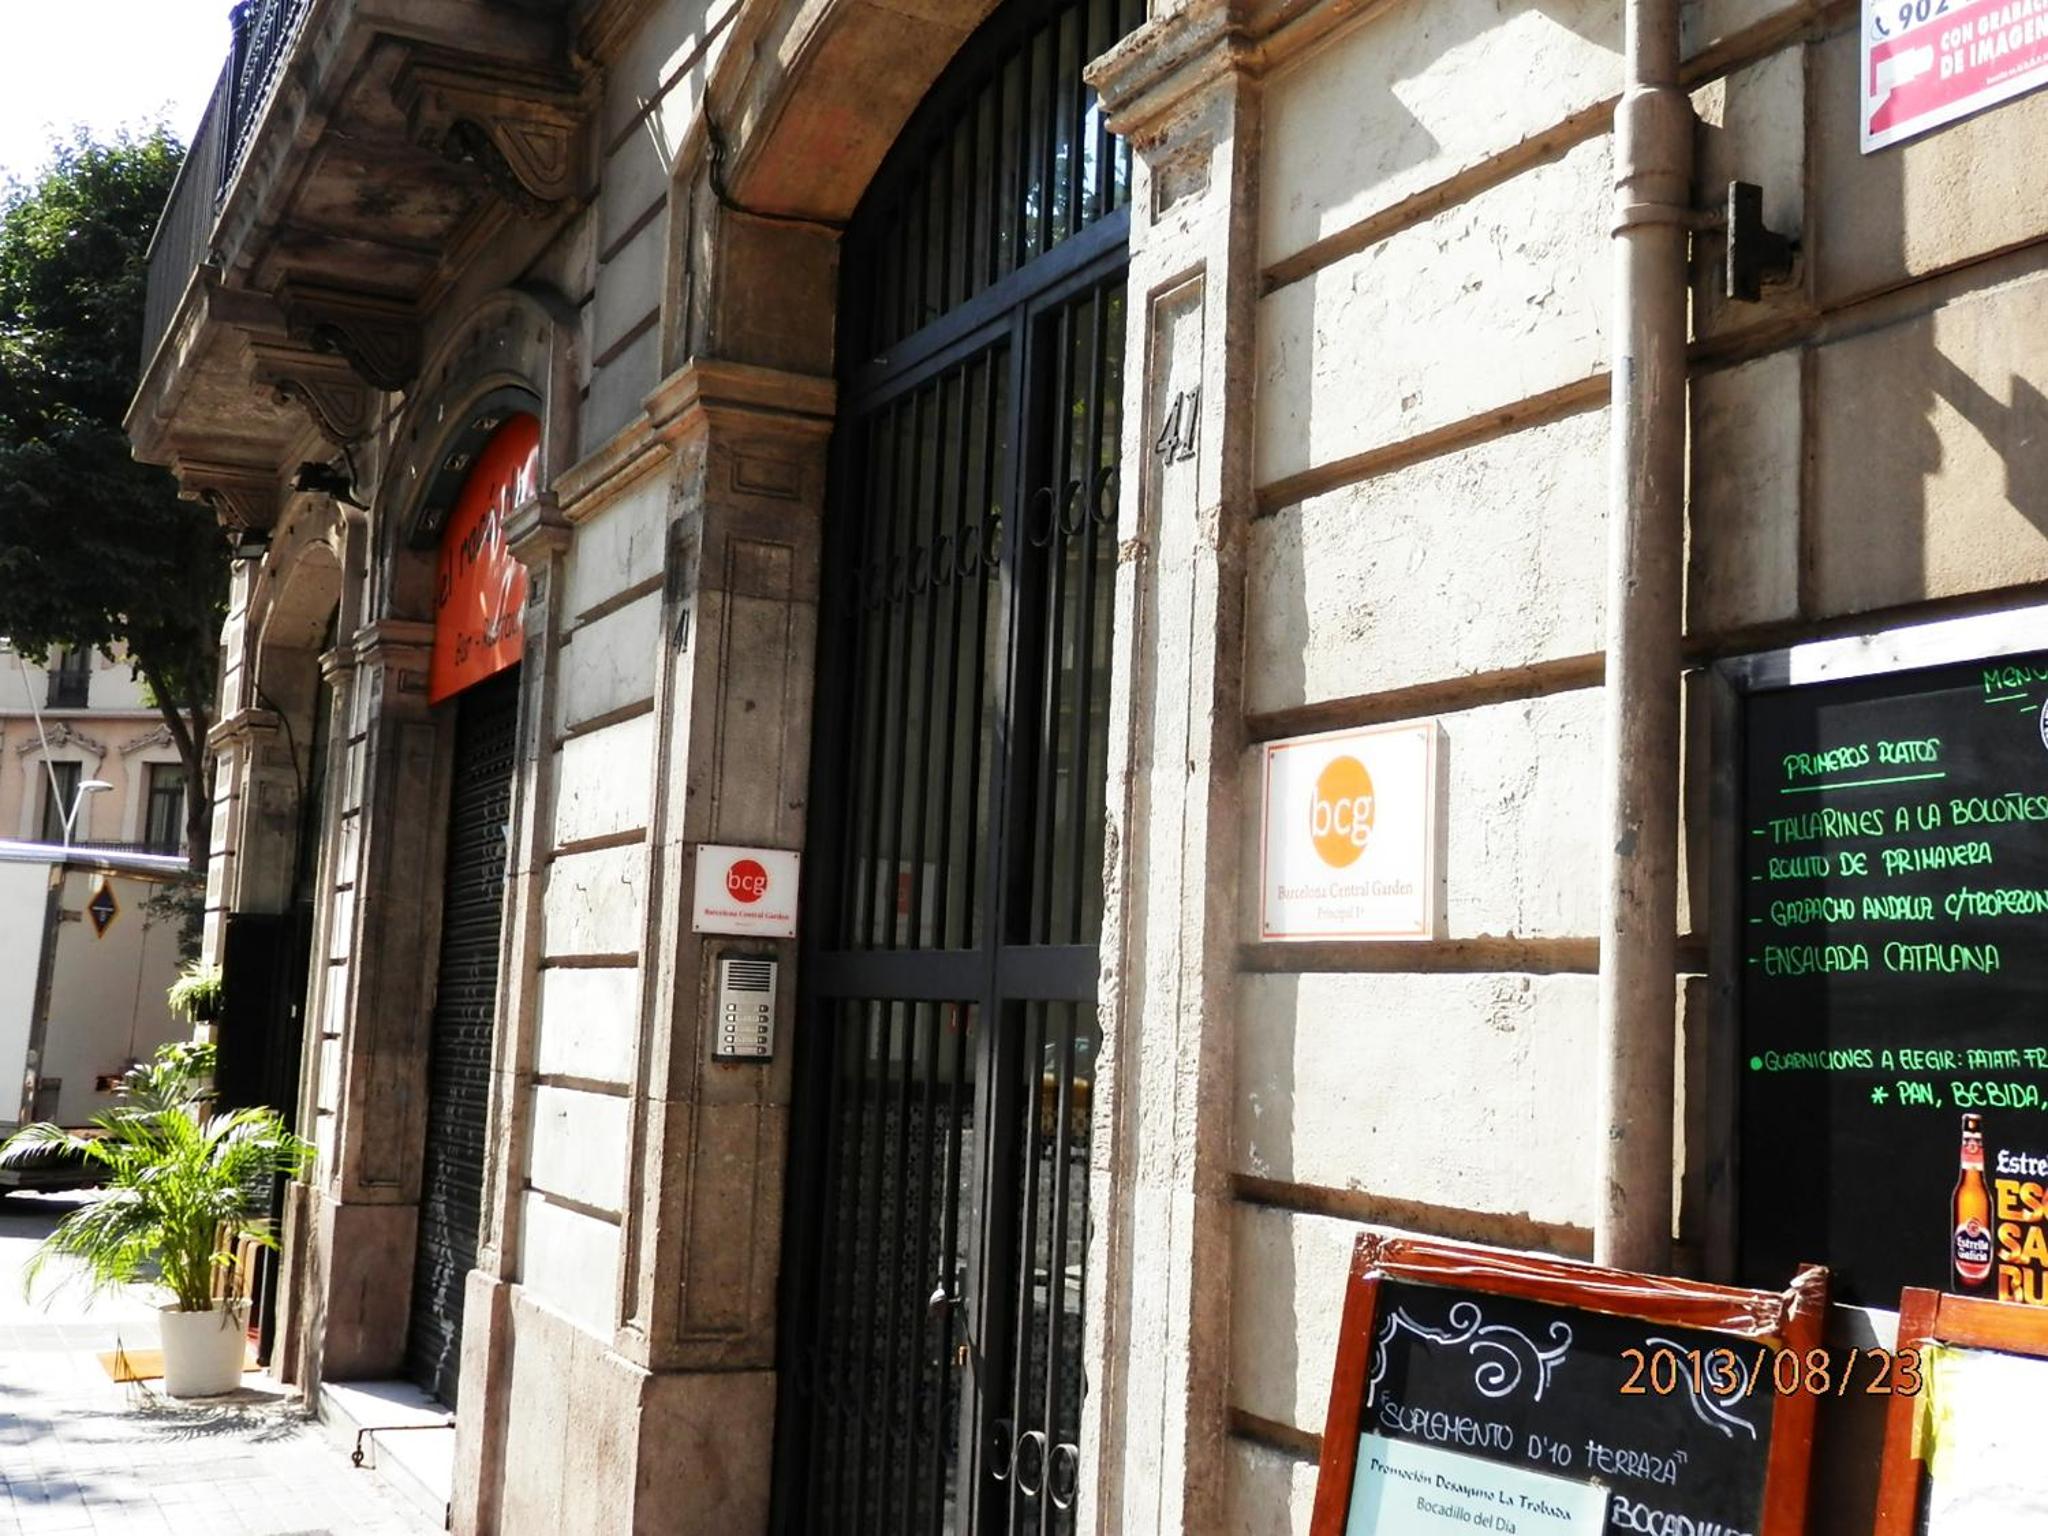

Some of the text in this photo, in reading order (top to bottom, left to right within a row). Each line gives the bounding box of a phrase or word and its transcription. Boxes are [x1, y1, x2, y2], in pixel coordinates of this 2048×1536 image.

[1940, 21, 1974, 50] CON
[1940, 50, 1964, 80] DE
[1155, 384, 1201, 468] 41
[1783, 738, 1940, 780] PRIMEROS PLATOS
[1312, 786, 1373, 847] bcg
[1769, 808, 1884, 844] TALLARINES
[1895, 807, 1909, 832] A
[1917, 804, 1941, 830] LA
[1769, 842, 1993, 880] ROLLITO DE PRIMAVERA
[728, 869, 766, 896] bcg
[1277, 879, 1414, 900] Barcelona Central Garden
[1771, 896, 1855, 927] GAZPACHO
[1863, 896, 1934, 920] ANDALUZ
[1765, 942, 1999, 976] ENSALADA CATALANA
[1765, 1049, 1874, 1071] GUARNICIONES
[1881, 1050, 1895, 1071] A
[1899, 1049, 1963, 1070] ELEGIR:
[1896, 1081, 1942, 1108] PAN,
[1996, 1149, 2048, 1177] Estre
[1416, 1496, 1472, 1523] Bocadillo
[1473, 1511, 1494, 1530] del
